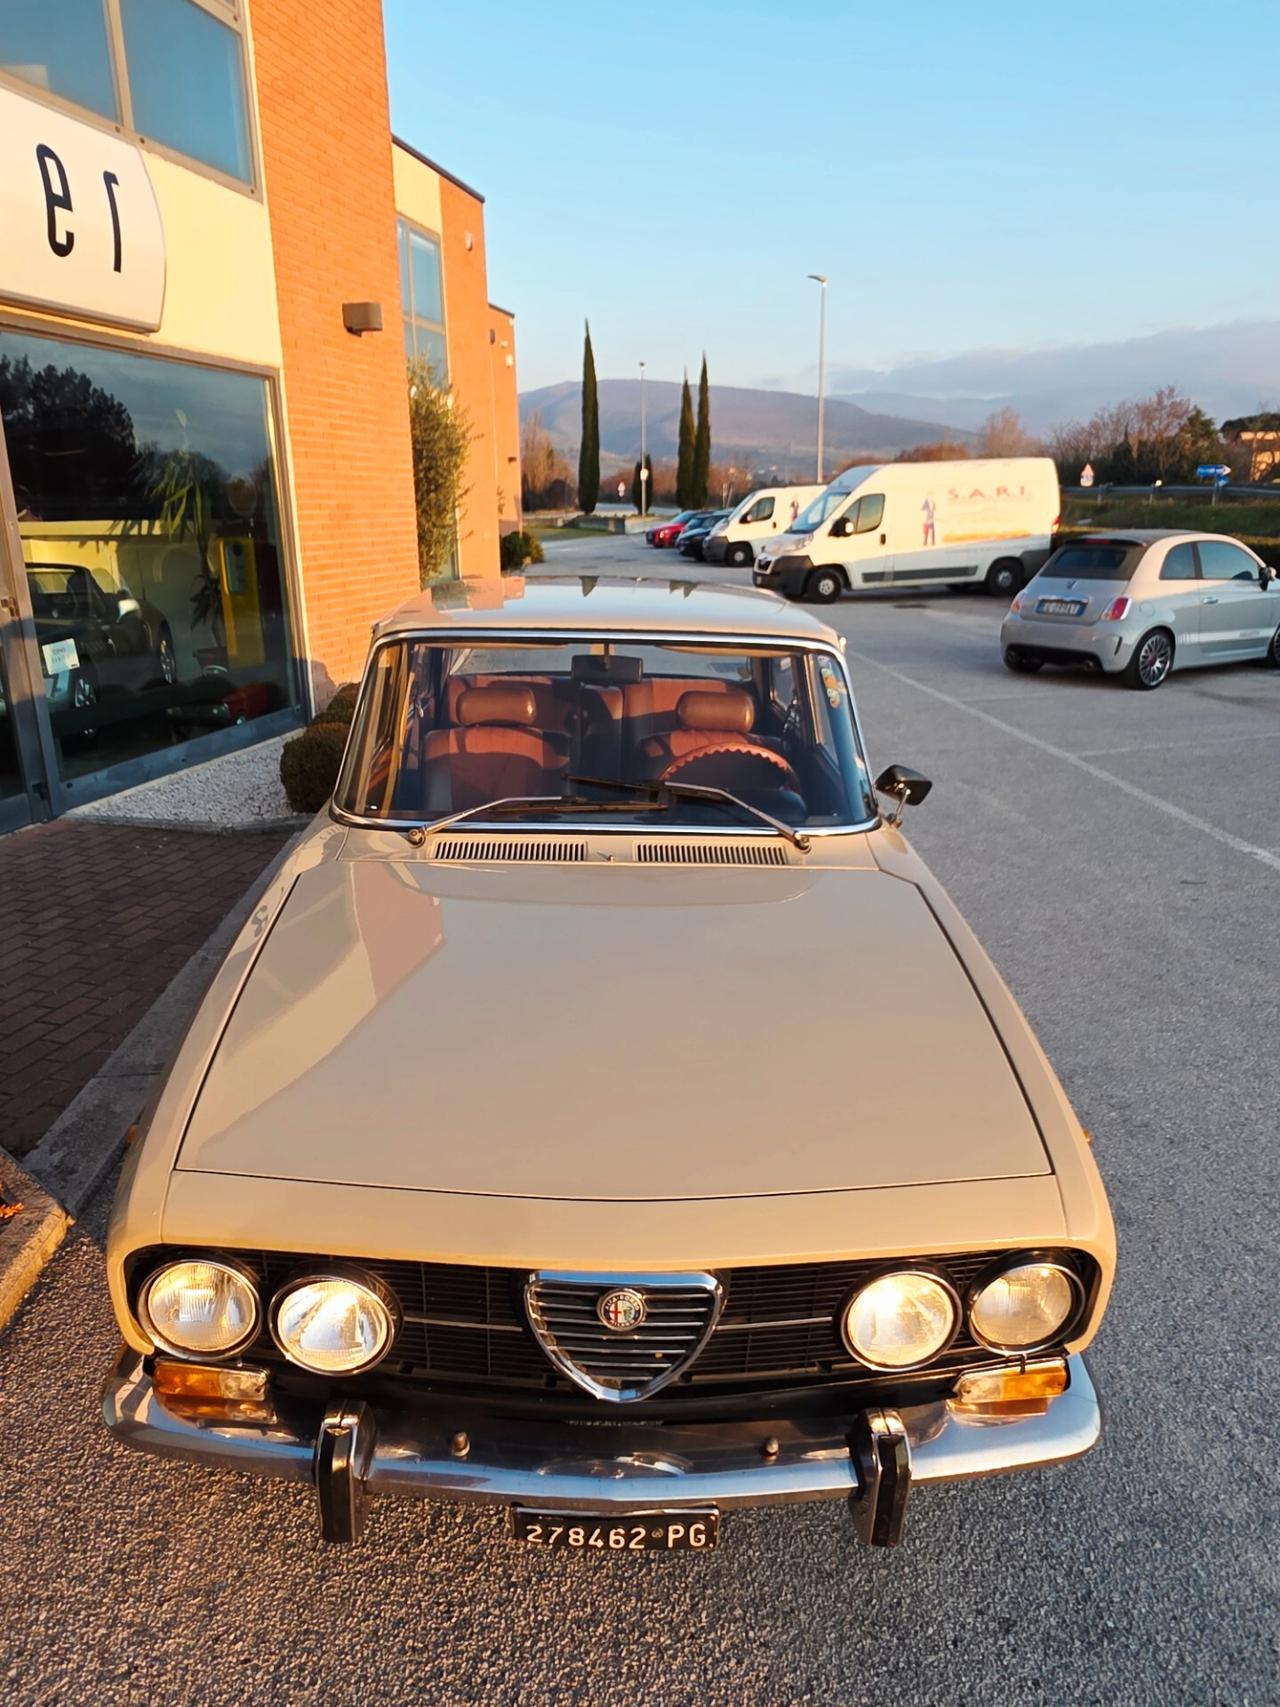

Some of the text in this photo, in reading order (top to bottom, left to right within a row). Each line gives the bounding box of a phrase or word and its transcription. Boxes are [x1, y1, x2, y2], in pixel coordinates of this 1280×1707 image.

[36, 143, 122, 273] er
[526, 1524, 706, 1549] 278462 PG
